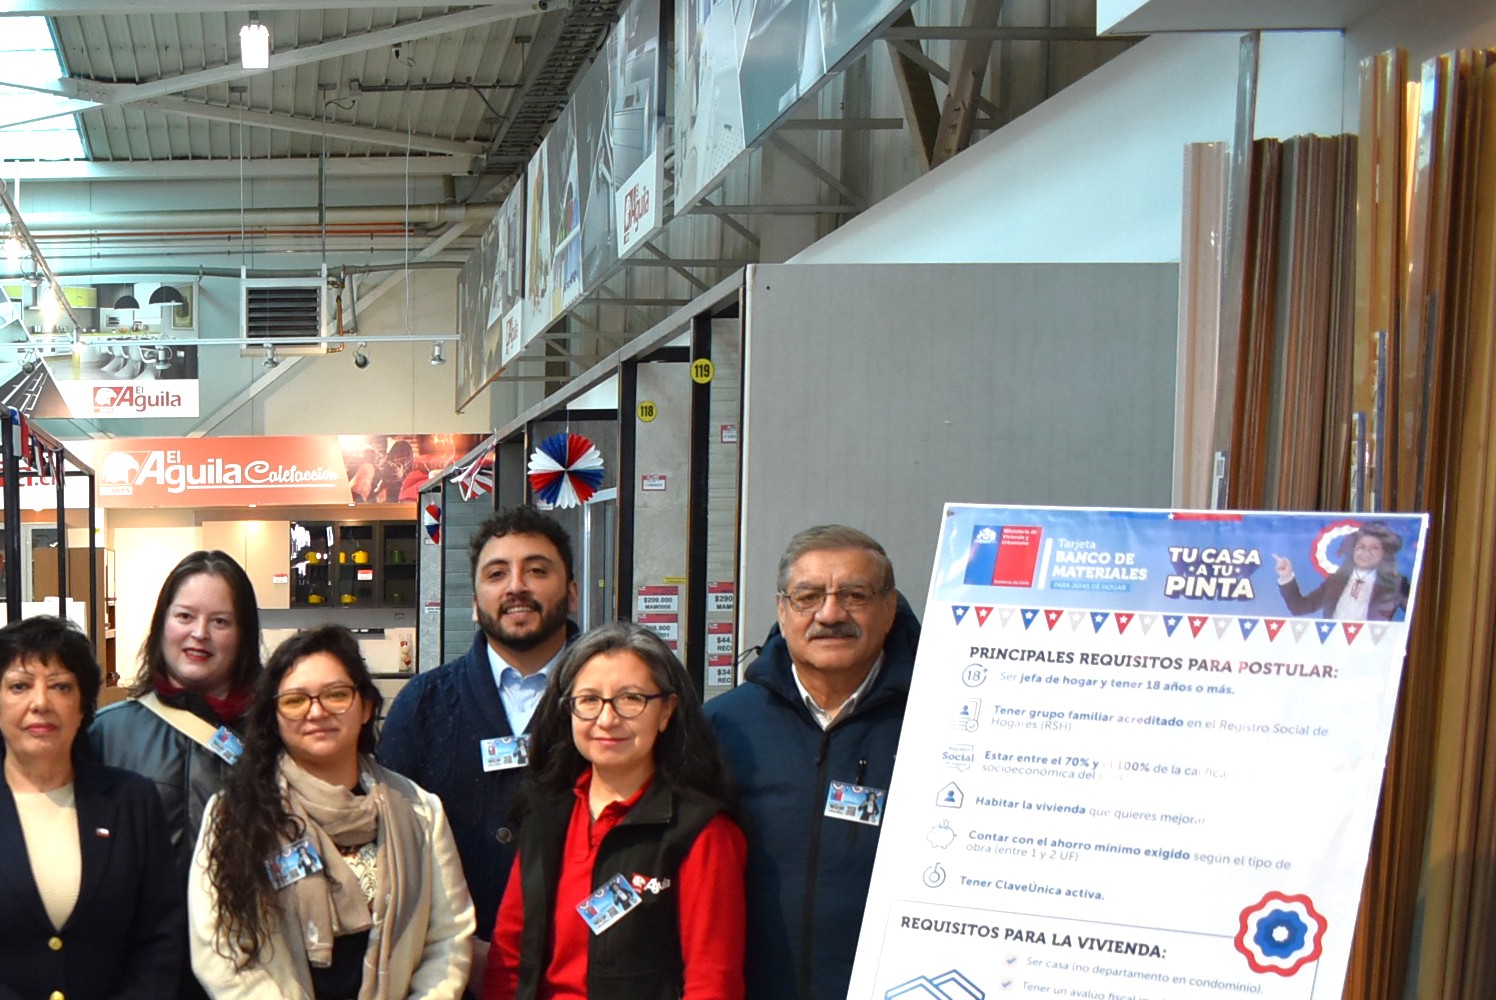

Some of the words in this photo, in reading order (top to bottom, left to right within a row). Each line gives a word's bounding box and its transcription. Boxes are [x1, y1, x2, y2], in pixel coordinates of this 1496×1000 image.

[694, 364, 711, 378] 119
[135, 386, 144, 394] El
[115, 386, 182, 412] Aguila
[640, 405, 654, 417] 118
[167, 450, 182, 464] El
[134, 450, 242, 493] Aguila
[1058, 538, 1096, 550] Tarjeta
[1056, 550, 1115, 565] BANCO
[1118, 552, 1135, 565] DE
[1168, 547, 1197, 564] TU
[1201, 548, 1261, 565] CASA
[1052, 565, 1148, 581] MATERIALES
[1196, 564, 1208, 575] A
[1212, 565, 1233, 575] TU
[1164, 575, 1256, 599] PINTA
[969, 646, 1075, 664] PRINCIPALES
[1079, 652, 1183, 670] REQUISITOS
[1188, 658, 1233, 673] PARA
[1238, 661, 1338, 679] POSTULAR:
[1000, 671, 1017, 681] Ser
[1019, 673, 1042, 684] jefa
[1045, 674, 1060, 684] de
[1062, 675, 1098, 688] hogar
[1100, 679, 1108, 689] y
[1110, 678, 1143, 689] tener
[1146, 680, 1161, 690] 18
[1163, 681, 1192, 692] años
[1195, 685, 1204, 693] o
[1206, 684, 1235, 695] más.
[942, 751, 975, 762] Social
[968, 830, 1009, 842] Contar
[1011, 836, 1034, 845] con
[1036, 837, 1048, 846] el
[1050, 838, 1092, 851] ahorro
[1094, 843, 1141, 856] mínimo
[1144, 848, 1190, 861] exigido
[1194, 853, 1231, 865] según
[1233, 856, 1245, 866] el
[1248, 856, 1273, 869] tipo
[1275, 859, 1291, 871] de
[960, 875, 992, 888] Tener
[995, 879, 1062, 896] ClaveÚnica
[1064, 888, 1105, 901] activa.
[901, 916, 1000, 939] REQUISITOS
[1004, 928, 1046, 945] PARA
[1051, 933, 1072, 948] LA
[1077, 936, 1167, 959] VIVIENDA:
